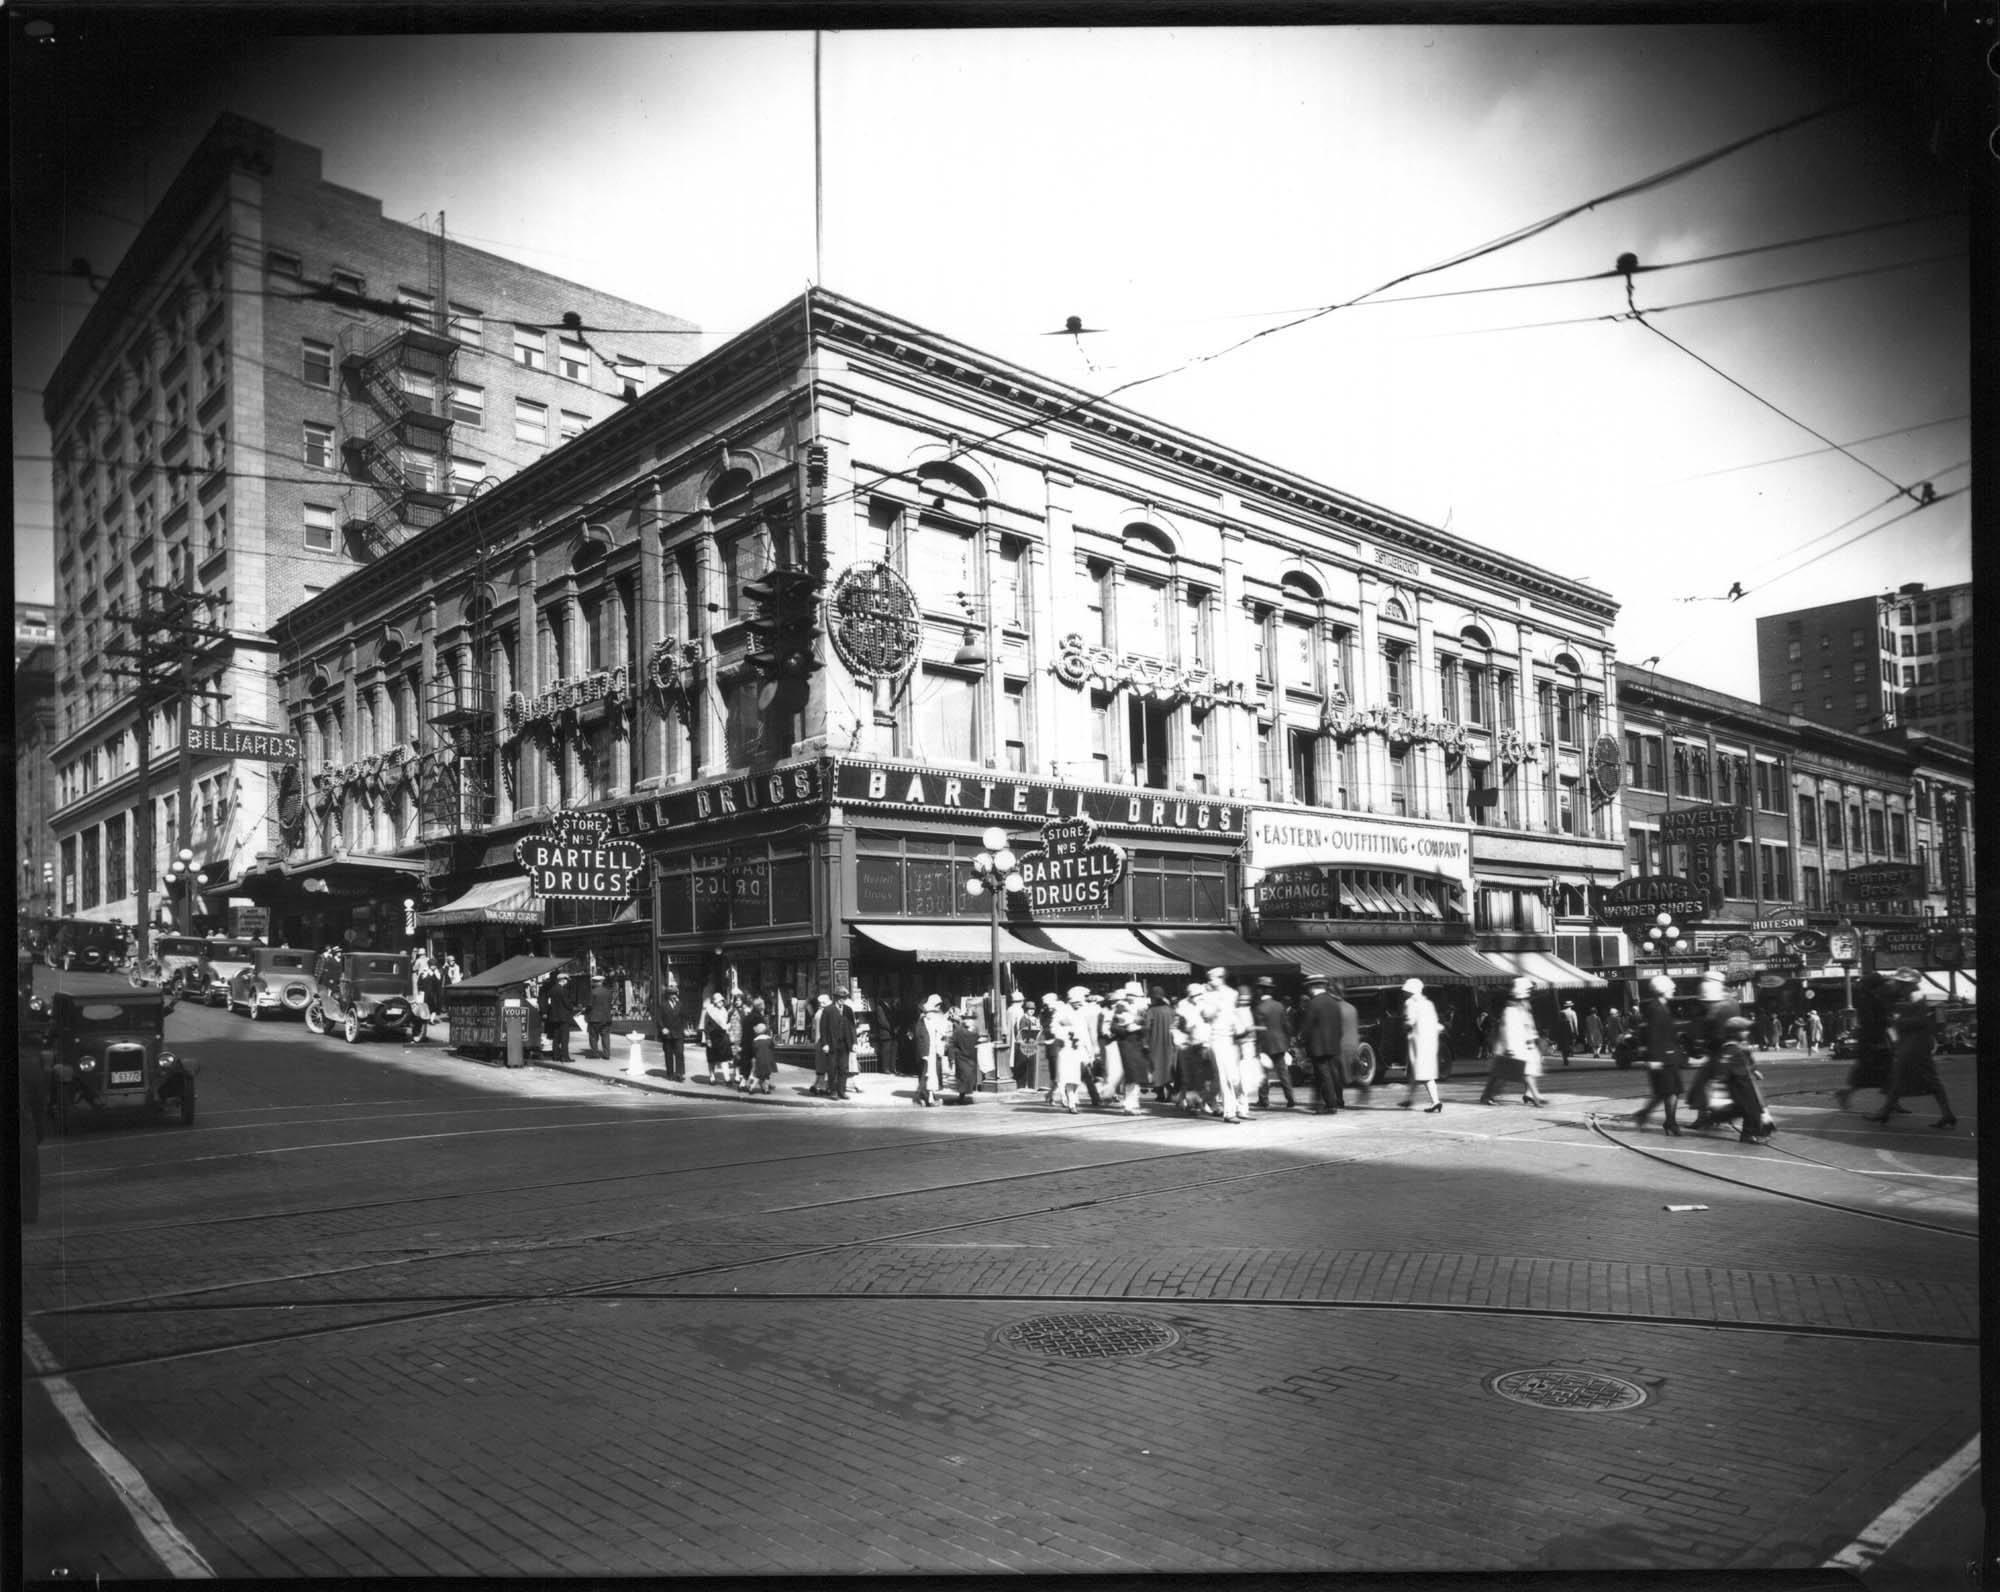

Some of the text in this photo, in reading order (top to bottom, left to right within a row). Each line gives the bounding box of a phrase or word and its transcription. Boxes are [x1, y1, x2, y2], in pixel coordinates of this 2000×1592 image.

[187, 727, 298, 758] BILLIARDS
[697, 769, 811, 819] DRUGS
[867, 769, 1232, 831] BARTELL DRUGS
[562, 818, 603, 832] STORE
[1664, 807, 1739, 827] NOVELTY
[1048, 825, 1084, 840] STORE
[1264, 824, 1462, 859] EASTERN OUTFITTING COMPANY
[1664, 823, 1739, 841] APPAREL
[537, 847, 632, 869] BARTELL
[1023, 855, 1114, 882] BARTELL
[544, 872, 622, 891] DRUGS
[1615, 880, 1688, 902] ALLAN'S
[1036, 881, 1100, 905] DRUGS
[1259, 883, 1329, 901] EXCHANGE
[1603, 900, 1704, 918] WONDER SHOES
[1752, 918, 1805, 931] HUTESON
[504, 1008, 527, 1016] YOUR
